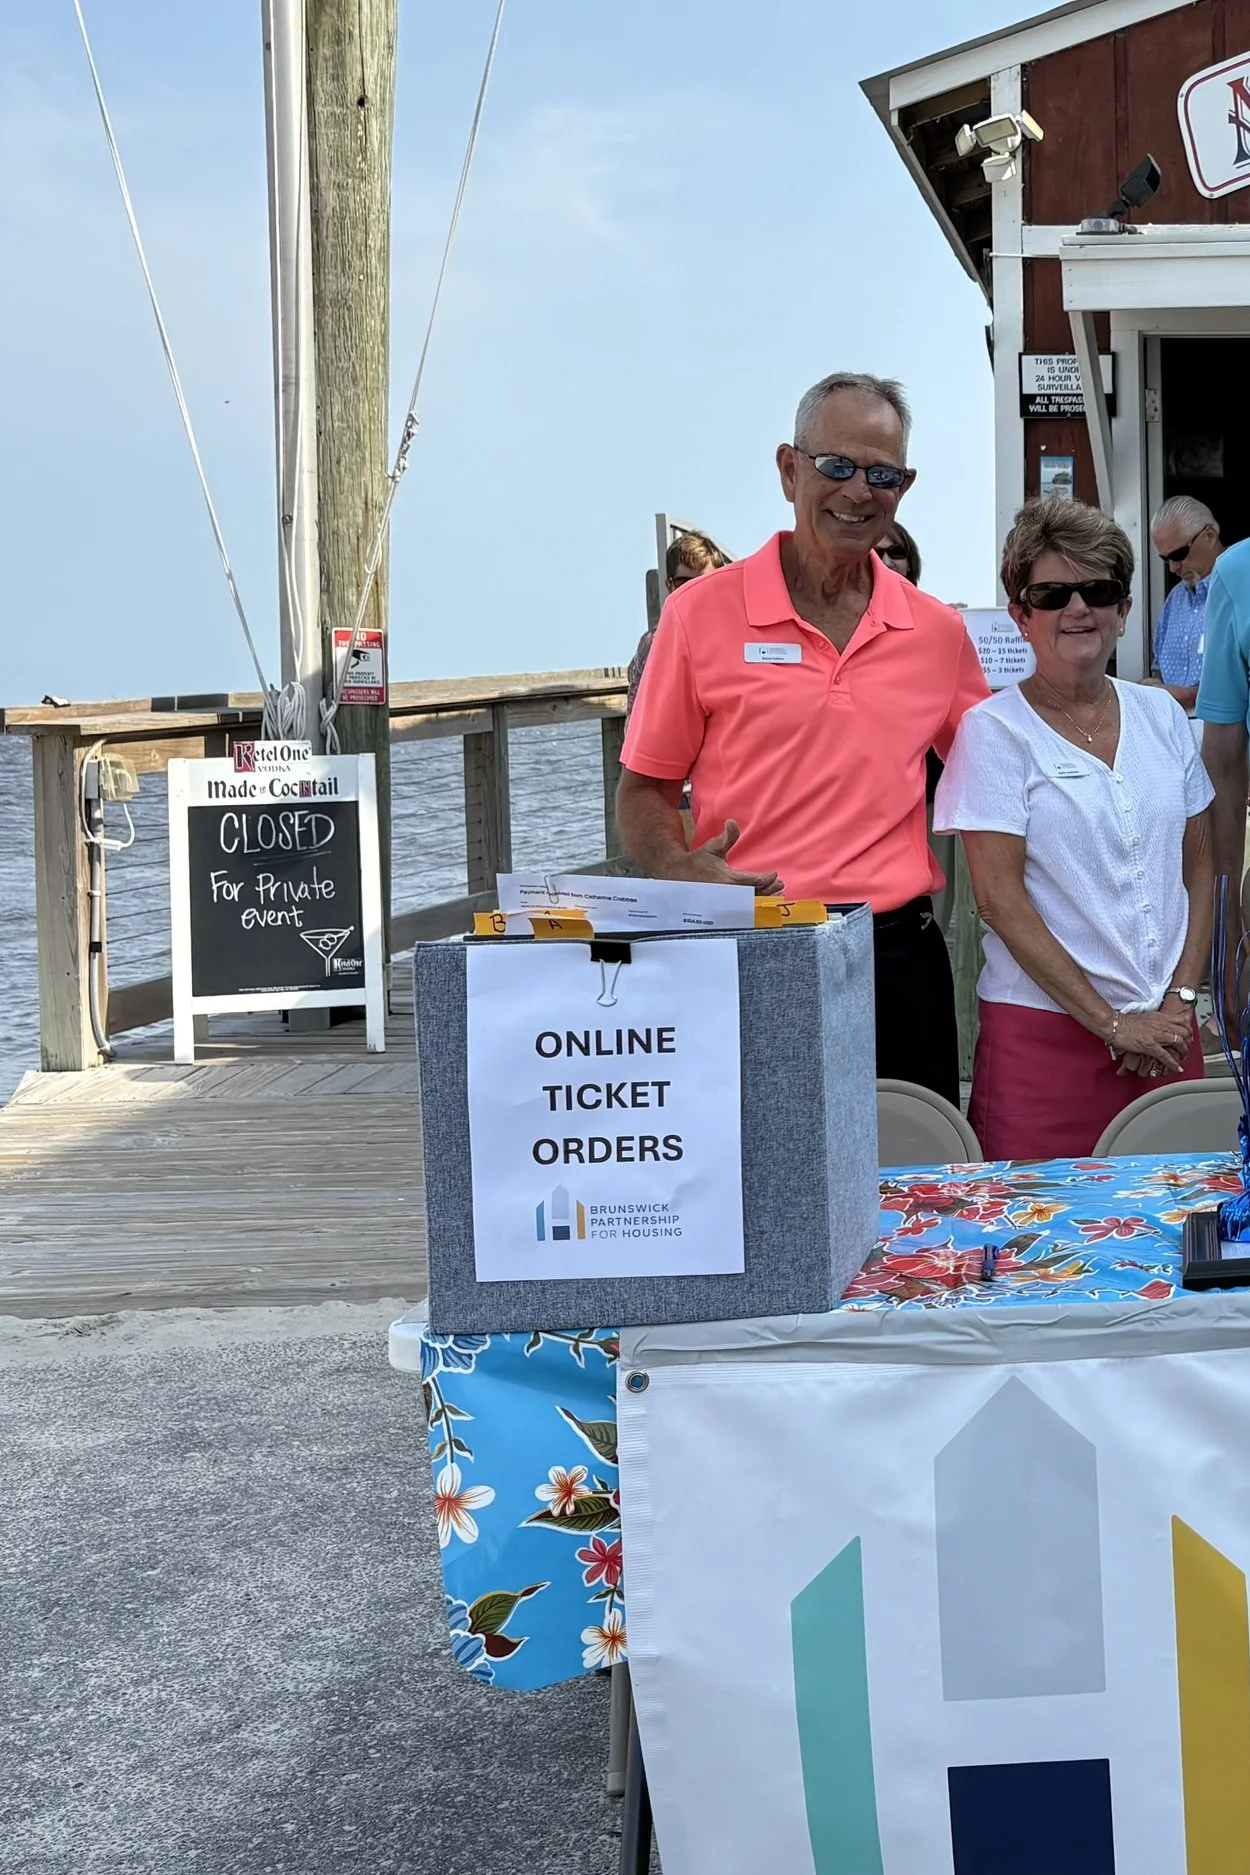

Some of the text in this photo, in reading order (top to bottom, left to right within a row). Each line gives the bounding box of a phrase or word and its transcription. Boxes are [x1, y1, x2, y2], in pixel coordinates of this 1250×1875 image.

[1029, 405, 1047, 413] WILL
[1035, 396, 1049, 404] ALL
[979, 636, 1003, 645] 50/50
[234, 742, 277, 772] Ketel
[208, 780, 256, 799] Made
[220, 810, 335, 854] CLOSED
[210, 866, 336, 904] For Private
[241, 905, 304, 930] event
[489, 914, 506, 933] B
[535, 1027, 676, 1058] ONLINE
[542, 1081, 671, 1111] TICKET
[532, 1135, 684, 1165] ORDERS
[590, 1203, 669, 1215] BRUNSWICK
[591, 1215, 680, 1226] PARTNERSHIP
[591, 1227, 683, 1239] FOR HOUSING
